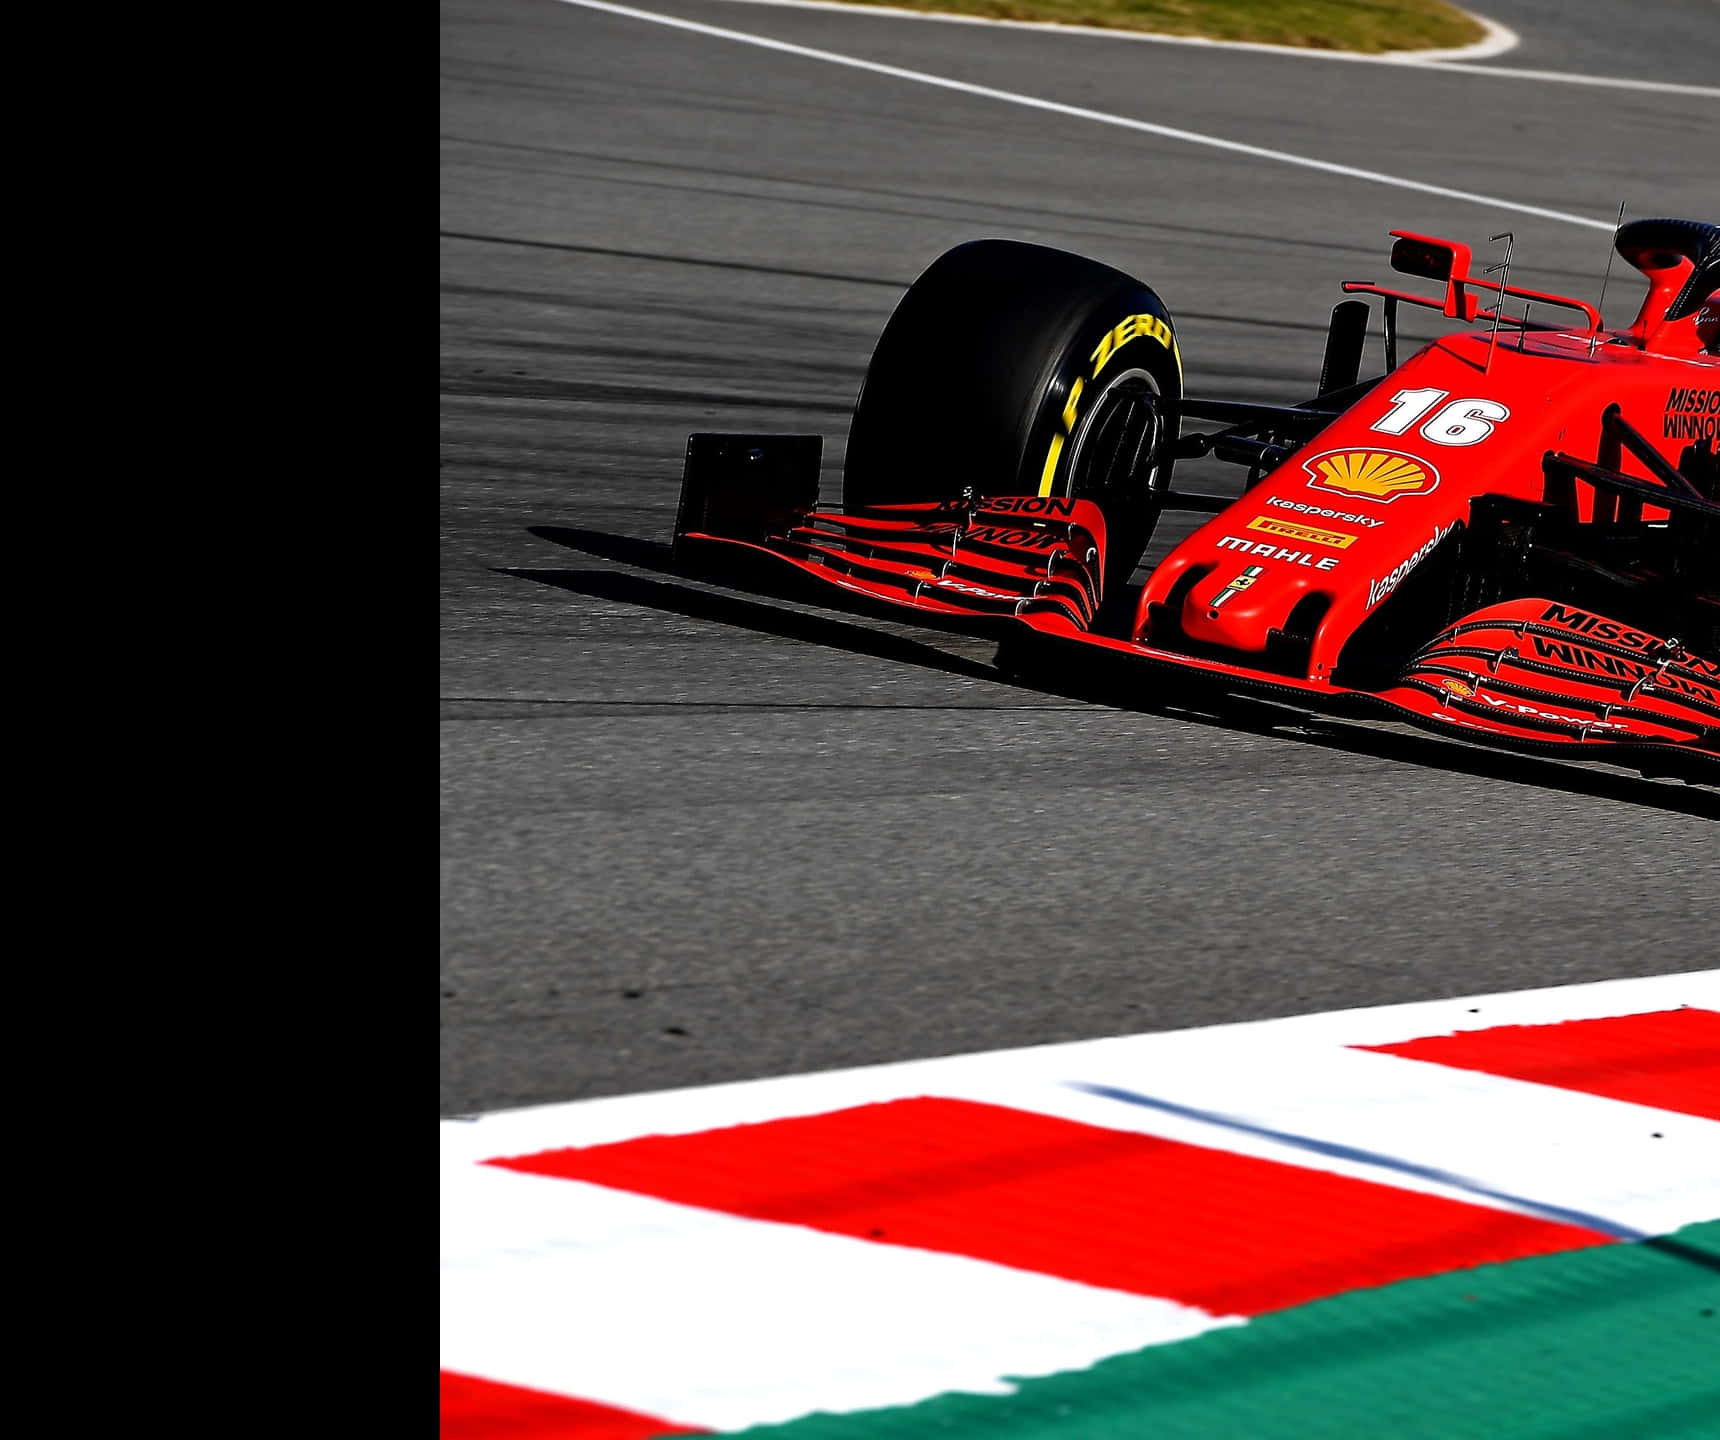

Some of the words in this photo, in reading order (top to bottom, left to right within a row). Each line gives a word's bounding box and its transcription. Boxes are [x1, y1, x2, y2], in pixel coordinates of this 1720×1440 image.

[1089, 313, 1172, 380] ZERO
[1369, 387, 1512, 447] 16
[1266, 496, 1385, 529] kaspersky
[1257, 519, 1347, 545] PIRELLI
[1215, 536, 1340, 571] MAHLE
[1480, 694, 1629, 729] V-Power
